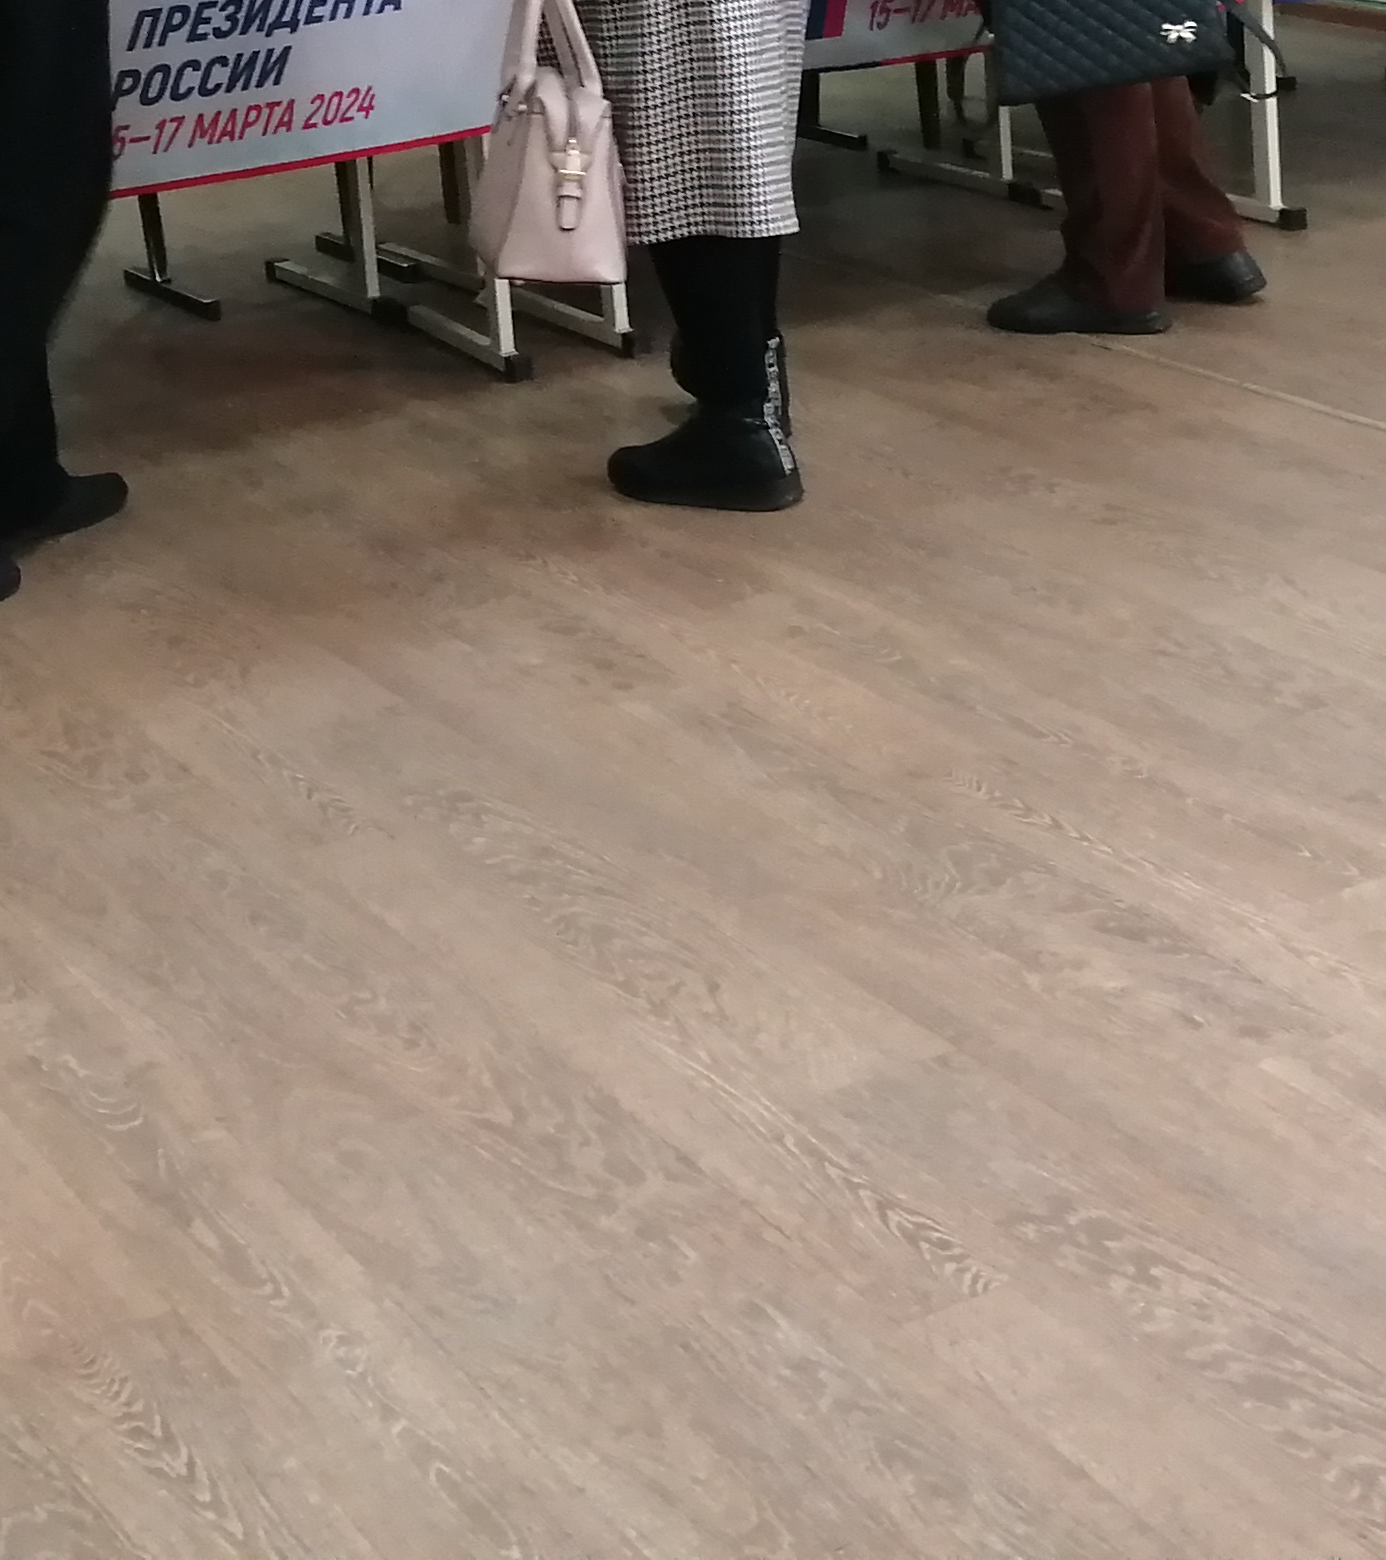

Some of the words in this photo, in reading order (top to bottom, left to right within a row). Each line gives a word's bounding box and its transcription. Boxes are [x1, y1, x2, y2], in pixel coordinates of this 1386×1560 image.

[112, 45, 292, 111] РОССИИ
[113, 114, 184, 161] 5–17
[187, 97, 295, 149] МАРТА
[302, 84, 376, 131] 2024
